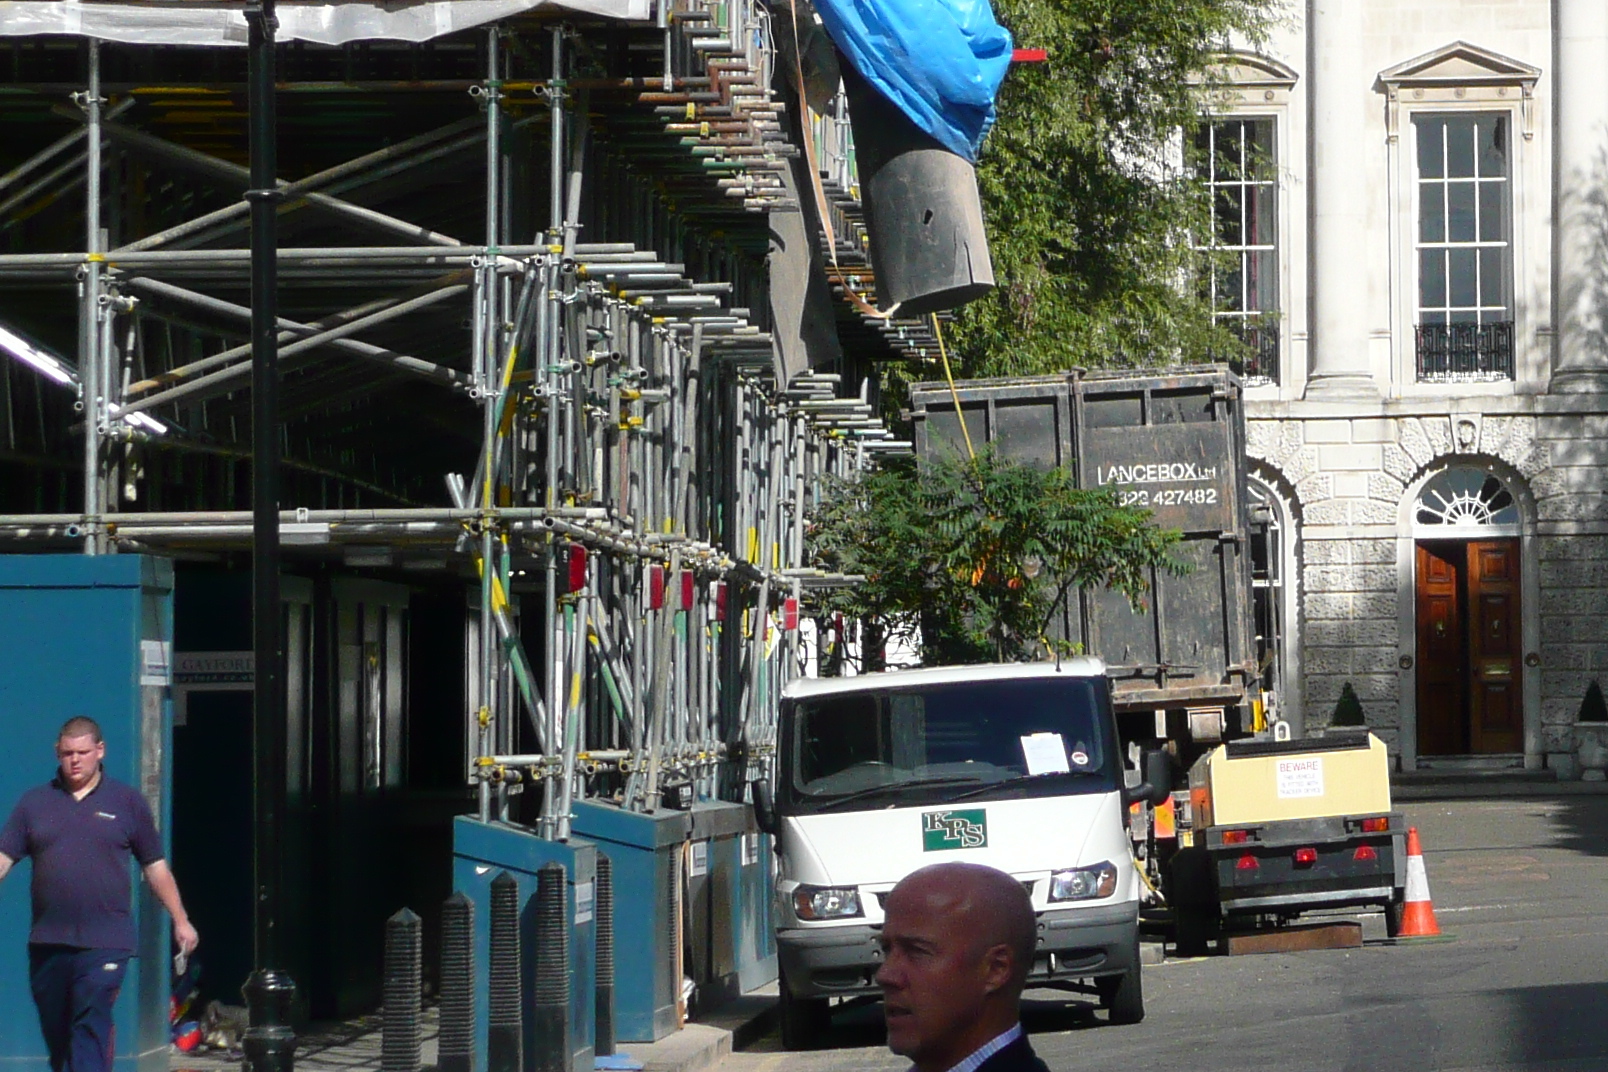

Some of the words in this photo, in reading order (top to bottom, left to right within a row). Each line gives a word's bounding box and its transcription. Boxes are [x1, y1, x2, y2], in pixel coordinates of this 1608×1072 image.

[1097, 462, 1197, 485] LANCEBOX
[1153, 488, 1217, 506] 427482
[1280, 760, 1319, 773] BEWARE
[924, 811, 985, 848] KPS
